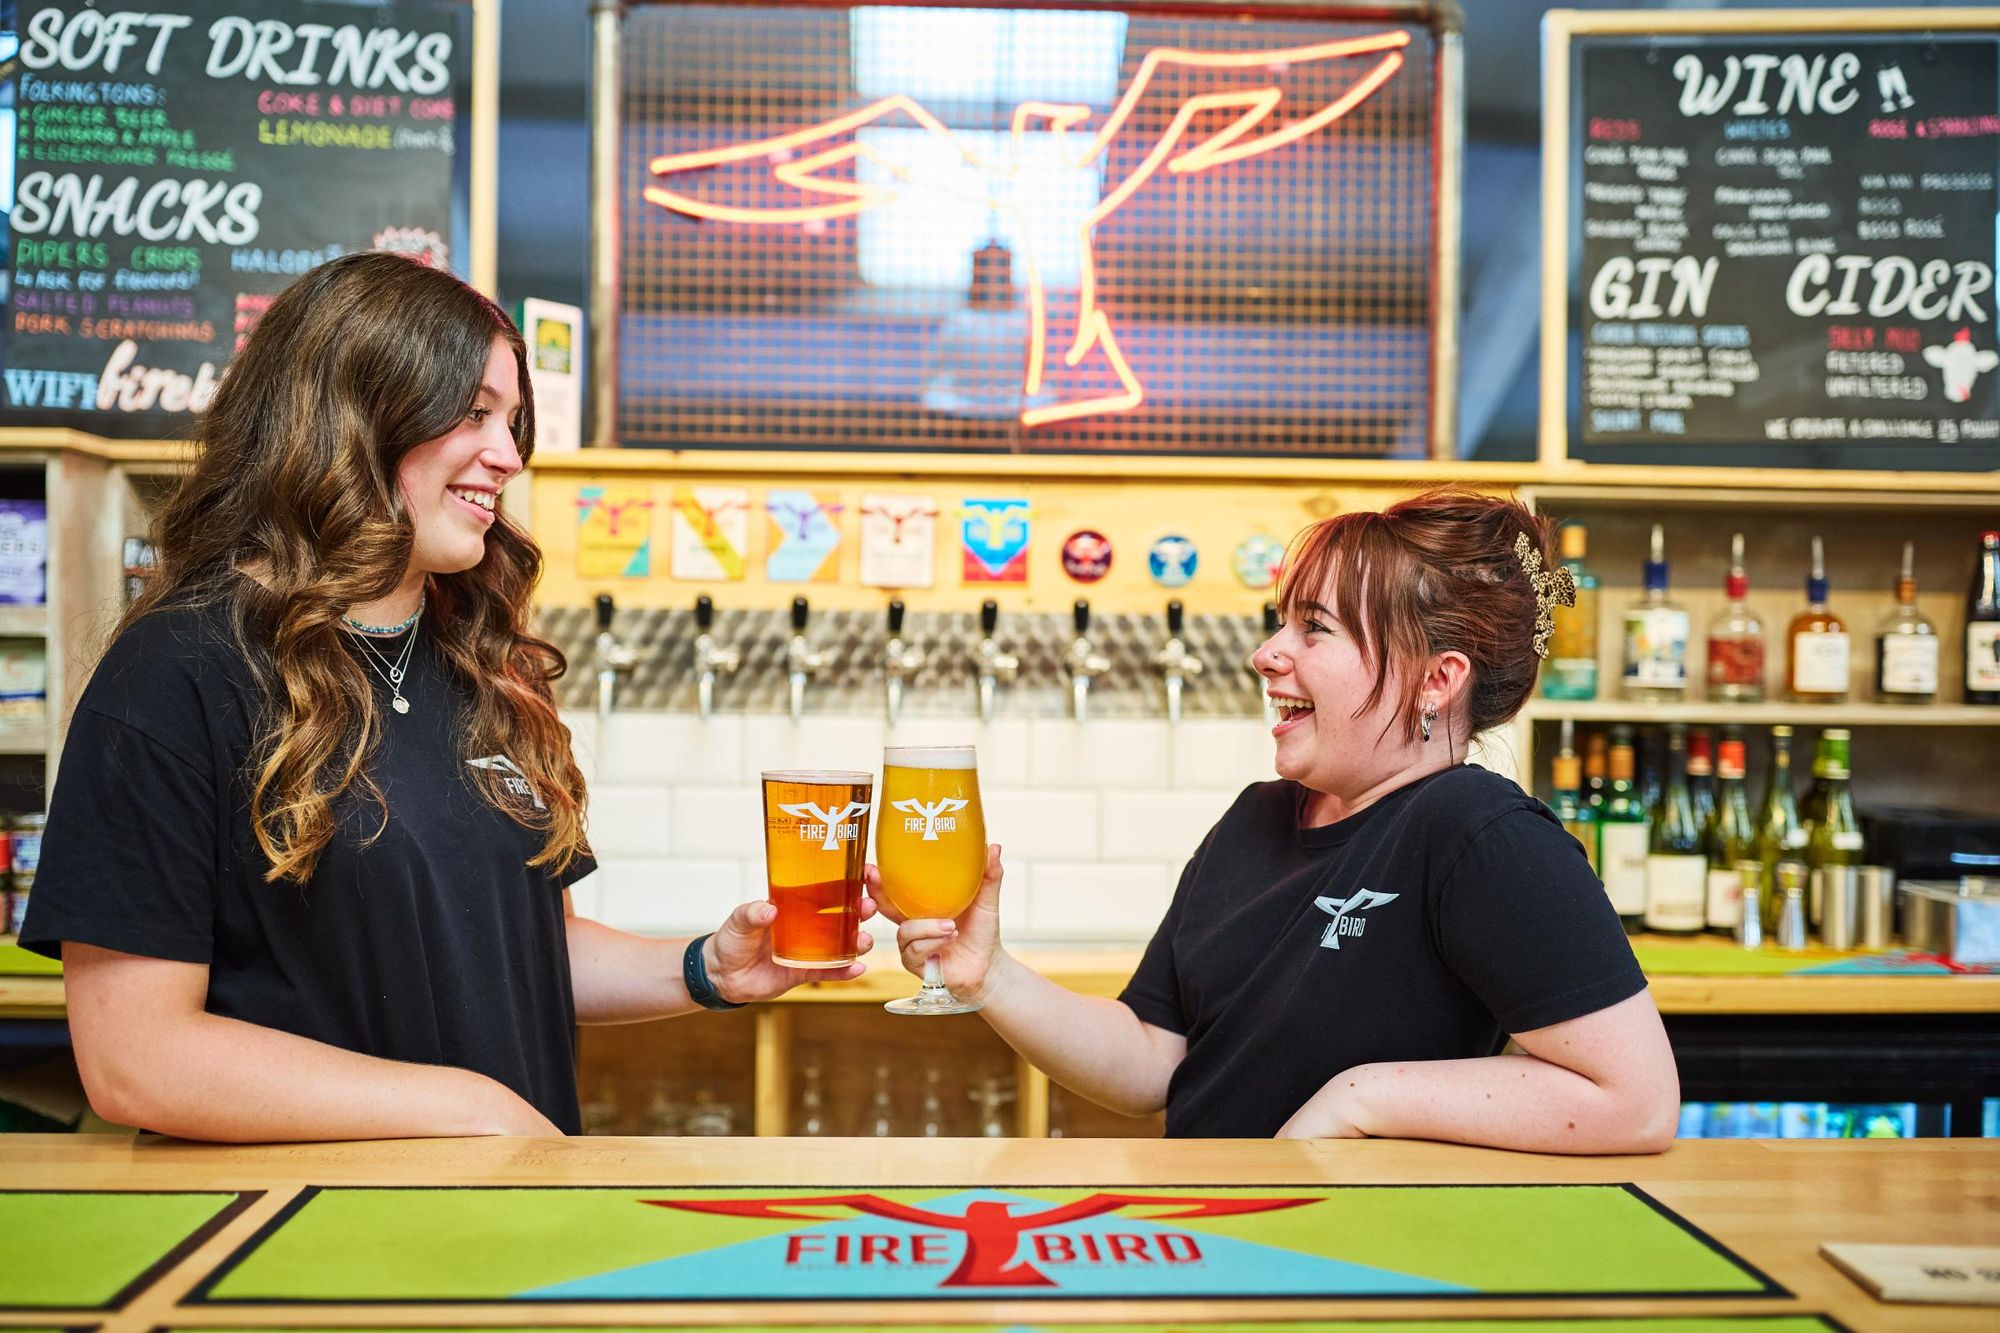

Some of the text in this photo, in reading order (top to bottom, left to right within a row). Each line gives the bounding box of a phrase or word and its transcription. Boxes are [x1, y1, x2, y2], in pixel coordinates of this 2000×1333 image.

[20, 8, 453, 95] SOFT DRINKS
[1672, 53, 1861, 117] WINE
[258, 90, 320, 116] COKE
[350, 95, 400, 118] DIET
[258, 119, 392, 149] LEMONADE
[10, 172, 262, 245] SNACKS
[16, 238, 203, 272] PIPERS CRISPS
[1589, 256, 1719, 320] GIN
[1786, 254, 1993, 323] CIDER
[15, 311, 72, 336] PORK
[1826, 350, 1905, 376] FILTERED
[4, 369, 98, 411] WIFI
[1826, 375, 1928, 401] UNFILTERED
[503, 777, 533, 796] FIRE
[800, 823, 859, 840] FIRE BIRD
[904, 816, 956, 832] FIRE BIRD
[1338, 915, 1366, 937] BIRD
[785, 1234, 1203, 1264] FIRE BIRD
